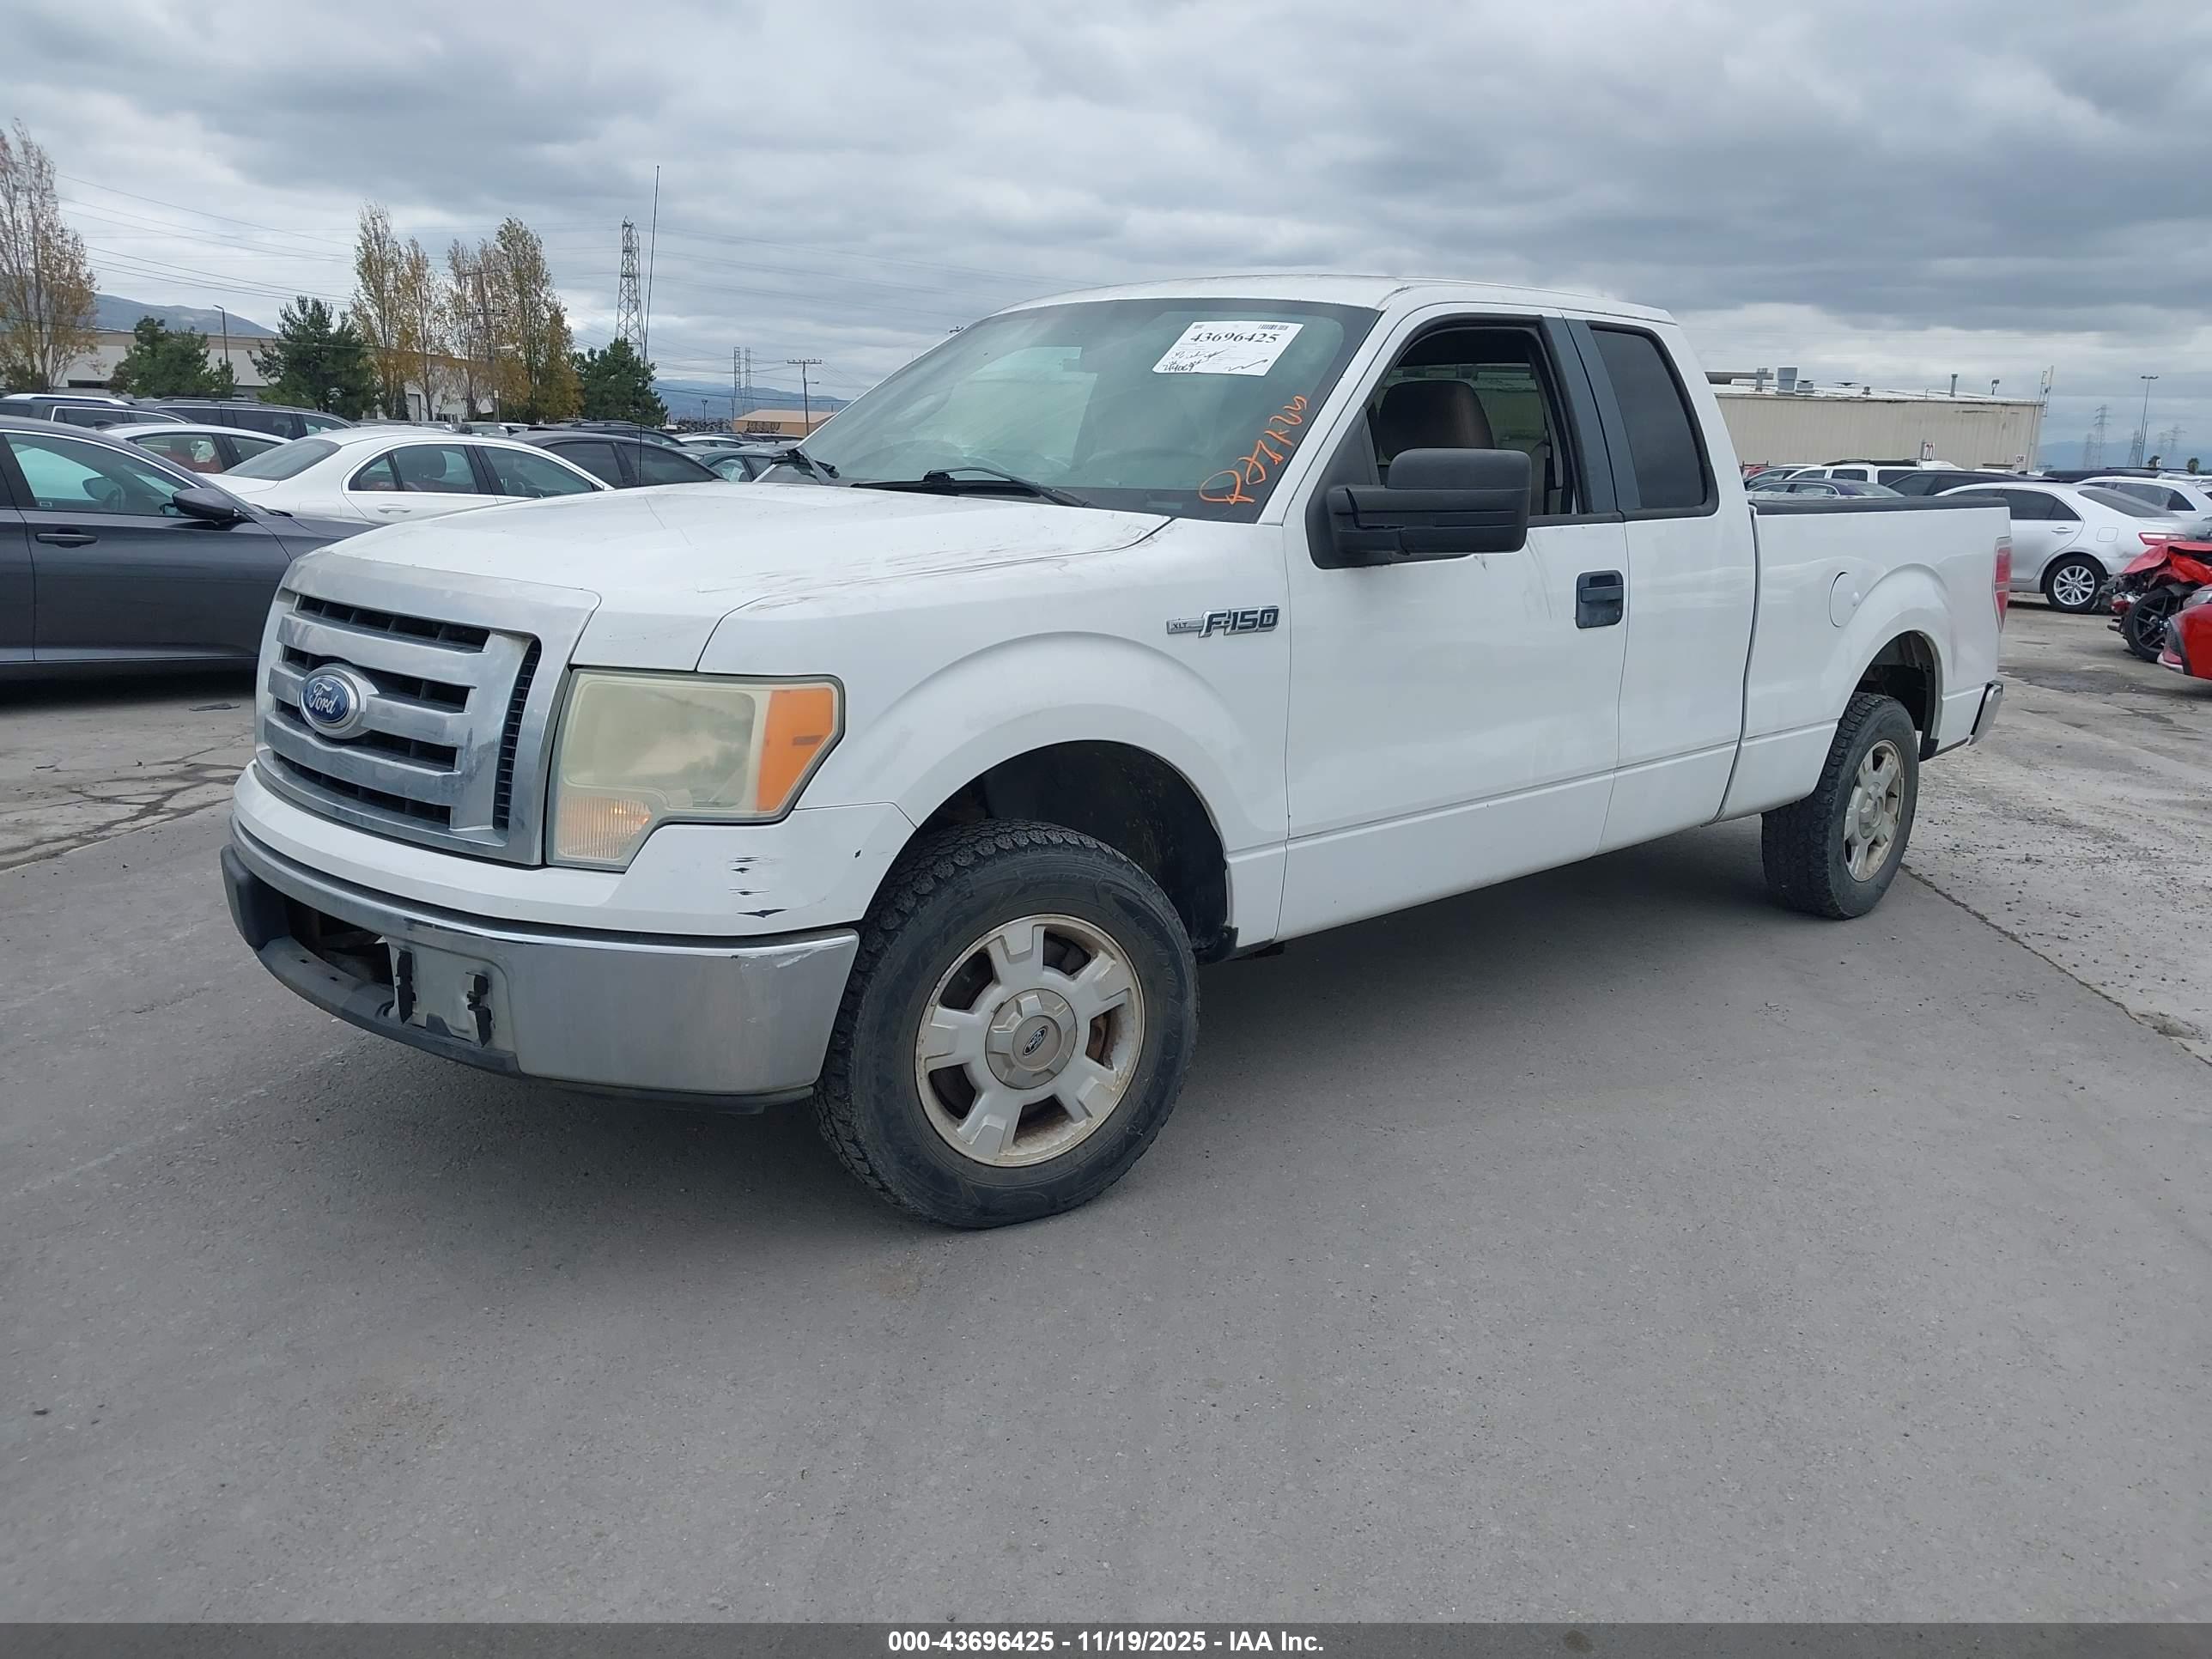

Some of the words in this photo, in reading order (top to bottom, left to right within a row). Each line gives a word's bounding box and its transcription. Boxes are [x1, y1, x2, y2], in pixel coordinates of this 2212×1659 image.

[1190, 332, 1281, 343] 43696425
[1200, 605, 1279, 637] F-150
[309, 683, 338, 714] Ford
